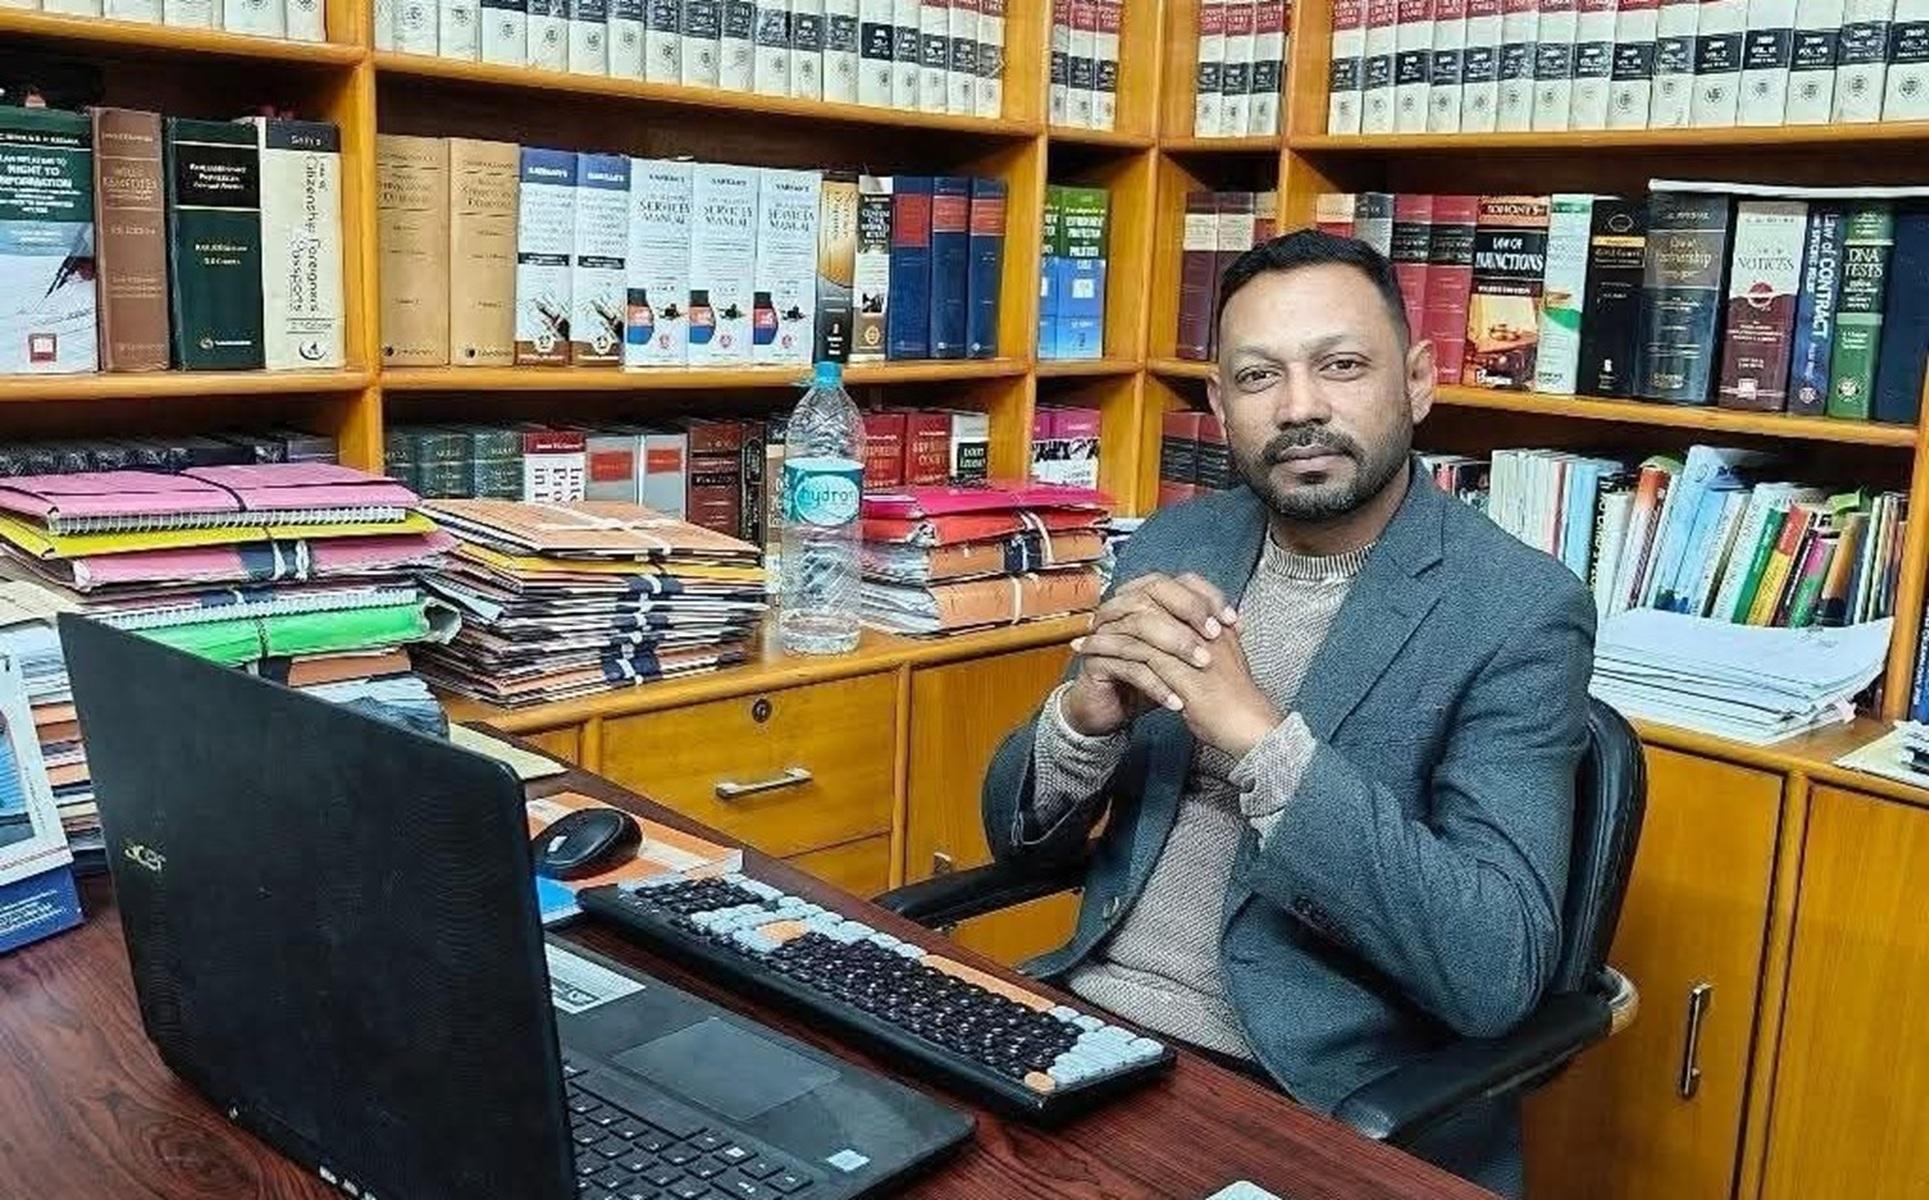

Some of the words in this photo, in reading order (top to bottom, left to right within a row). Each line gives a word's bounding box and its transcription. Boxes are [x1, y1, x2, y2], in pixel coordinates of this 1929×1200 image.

[1849, 248, 1880, 263] DNA
[1844, 263, 1884, 278] TESTS
[1811, 258, 1837, 340] CONTRACT
